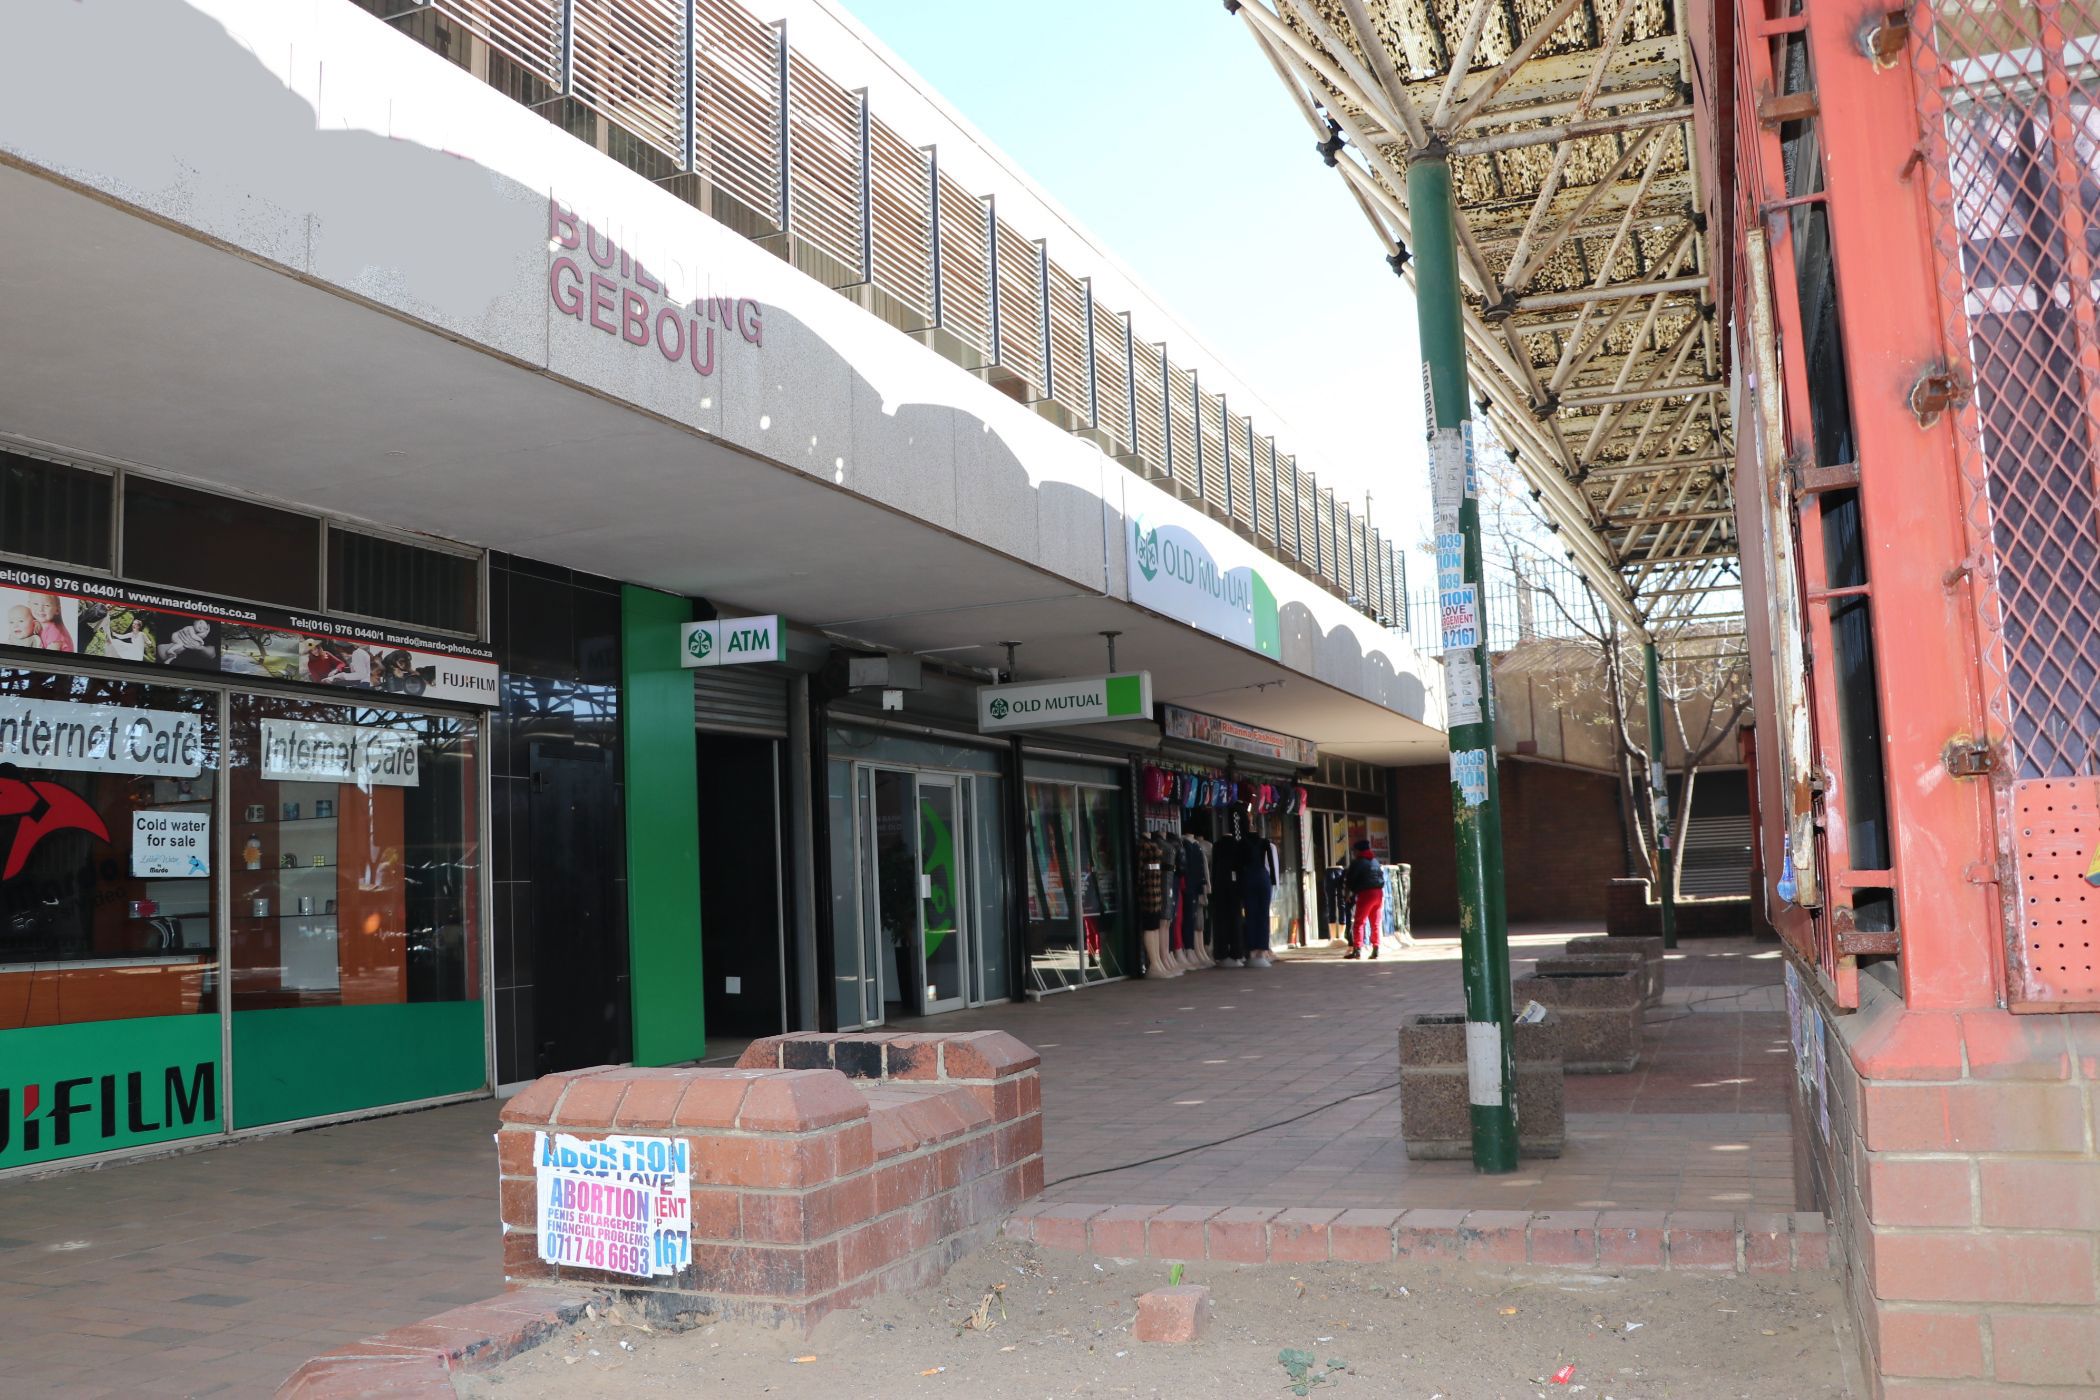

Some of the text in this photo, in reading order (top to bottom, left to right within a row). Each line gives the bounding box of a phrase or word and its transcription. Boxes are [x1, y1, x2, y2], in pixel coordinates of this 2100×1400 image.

[550, 190, 763, 348] BUILING
[550, 256, 715, 377] GEBOU
[1464, 423, 1475, 491] PENIS
[1163, 539, 1252, 613] OLD MUTUAL
[54, 577, 80, 592] 976
[82, 582, 124, 599] 0440/1
[128, 590, 257, 621] www.mardofotos.co.za
[1440, 590, 1472, 608] TION
[290, 616, 494, 658] Tel:(016) 976 0440/1 mardo@mardo-photo.co.za
[727, 628, 771, 653] ATM
[1450, 627, 1475, 647] 2167
[442, 672, 496, 692] FUJIFILM
[1013, 693, 1103, 713] OLD MUTUAL
[130, 716, 199, 766] Café
[136, 817, 206, 832] Cold water
[147, 834, 196, 847] for sale
[542, 1138, 686, 1174] ABORTION
[550, 1177, 650, 1222] ABORTION
[547, 1207, 648, 1235] PENIS ENLARGEMENT
[547, 1220, 650, 1248] FINANCIAL PROBLEMS
[608, 1242, 650, 1275] 6693
[653, 1228, 688, 1268] 167
